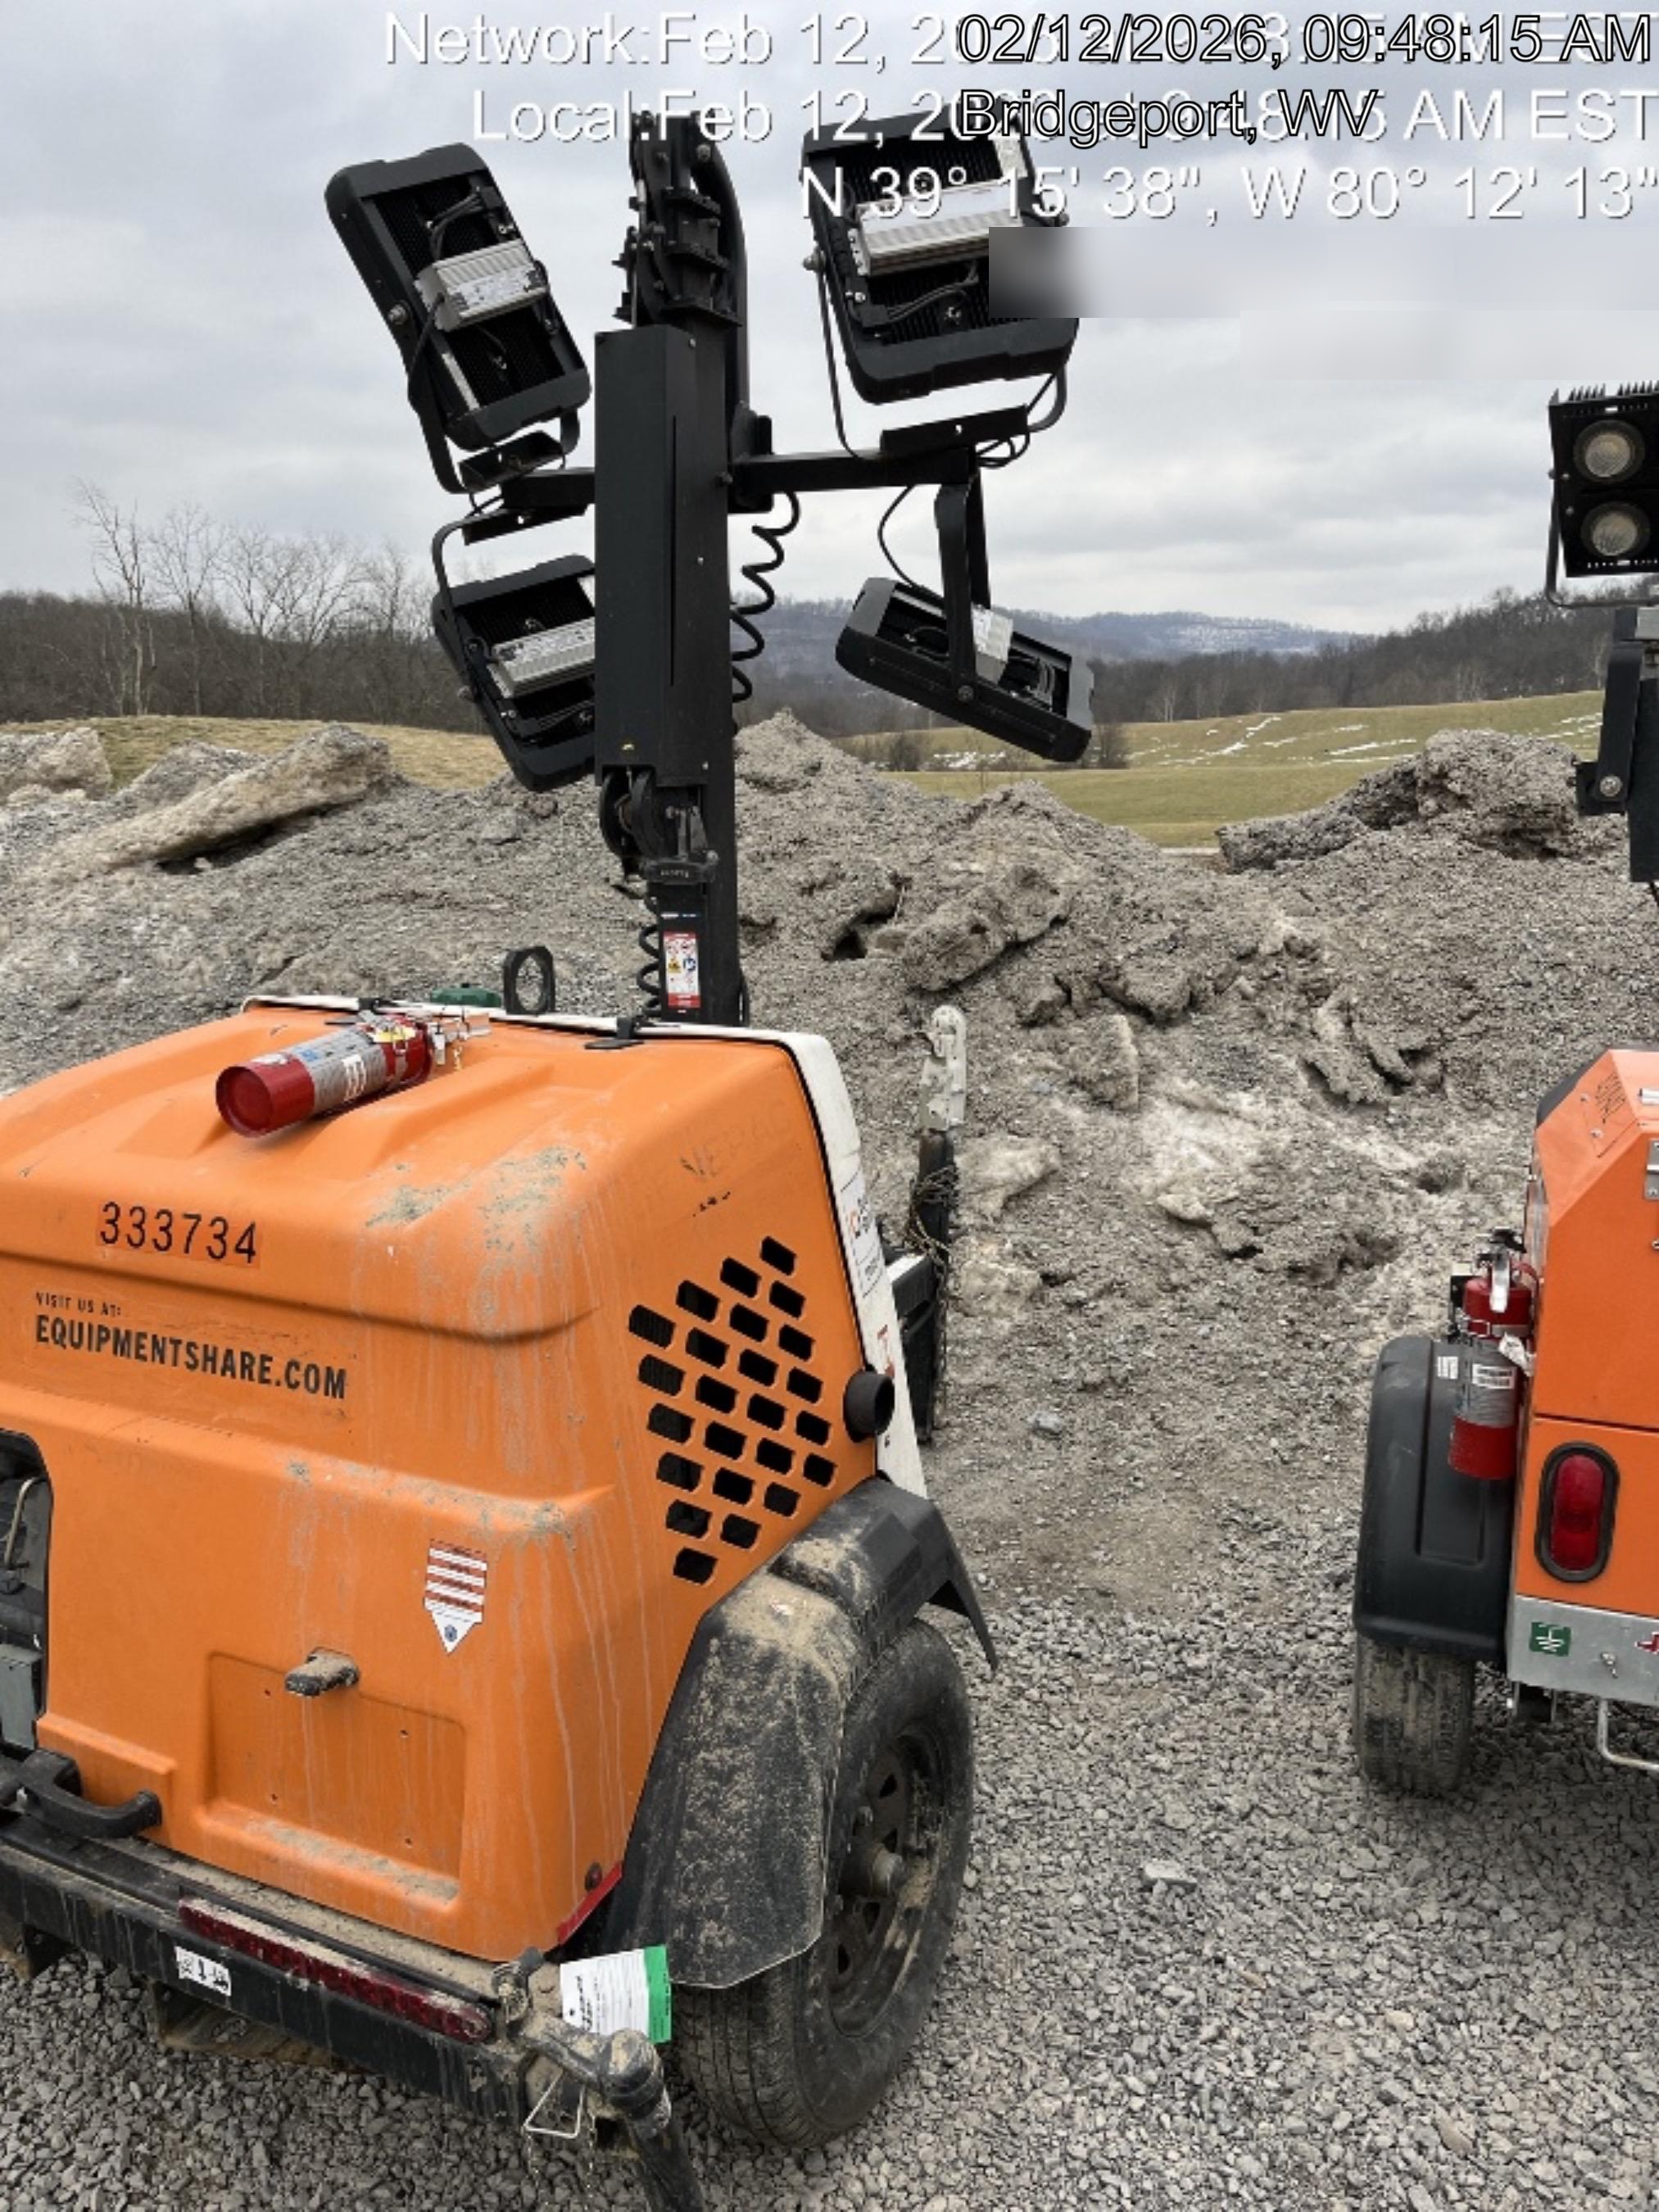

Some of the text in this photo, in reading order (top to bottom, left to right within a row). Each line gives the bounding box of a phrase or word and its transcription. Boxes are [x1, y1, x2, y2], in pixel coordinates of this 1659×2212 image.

[99, 1201, 257, 1263] 333734
[36, 1292, 122, 1317] VISIT US AT:
[35, 1314, 347, 1400] EQUIPMENTSHARE.COM
